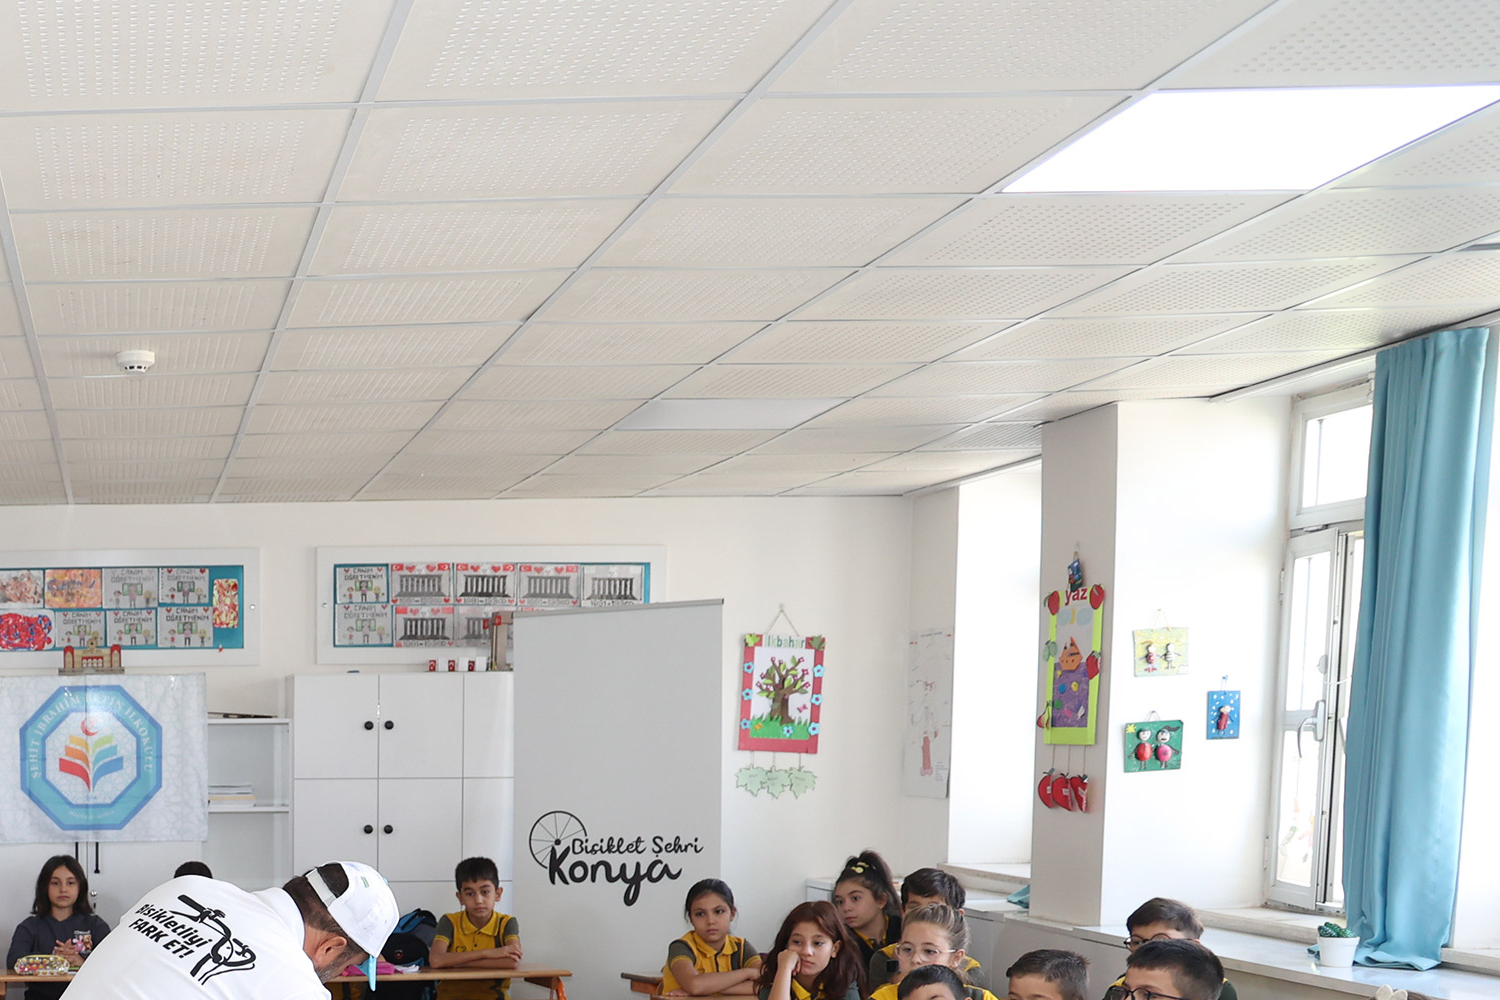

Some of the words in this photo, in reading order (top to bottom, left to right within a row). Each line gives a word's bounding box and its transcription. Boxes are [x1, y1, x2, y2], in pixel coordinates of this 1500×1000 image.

[1065, 588, 1088, 606] yaz
[571, 836, 647, 855] Bisiklet
[652, 836, 704, 858] Şehri
[549, 844, 683, 907] Konya
[128, 918, 169, 943] FARK
[162, 939, 195, 959] ET!
[135, 904, 213, 948] Bisikletliyi
